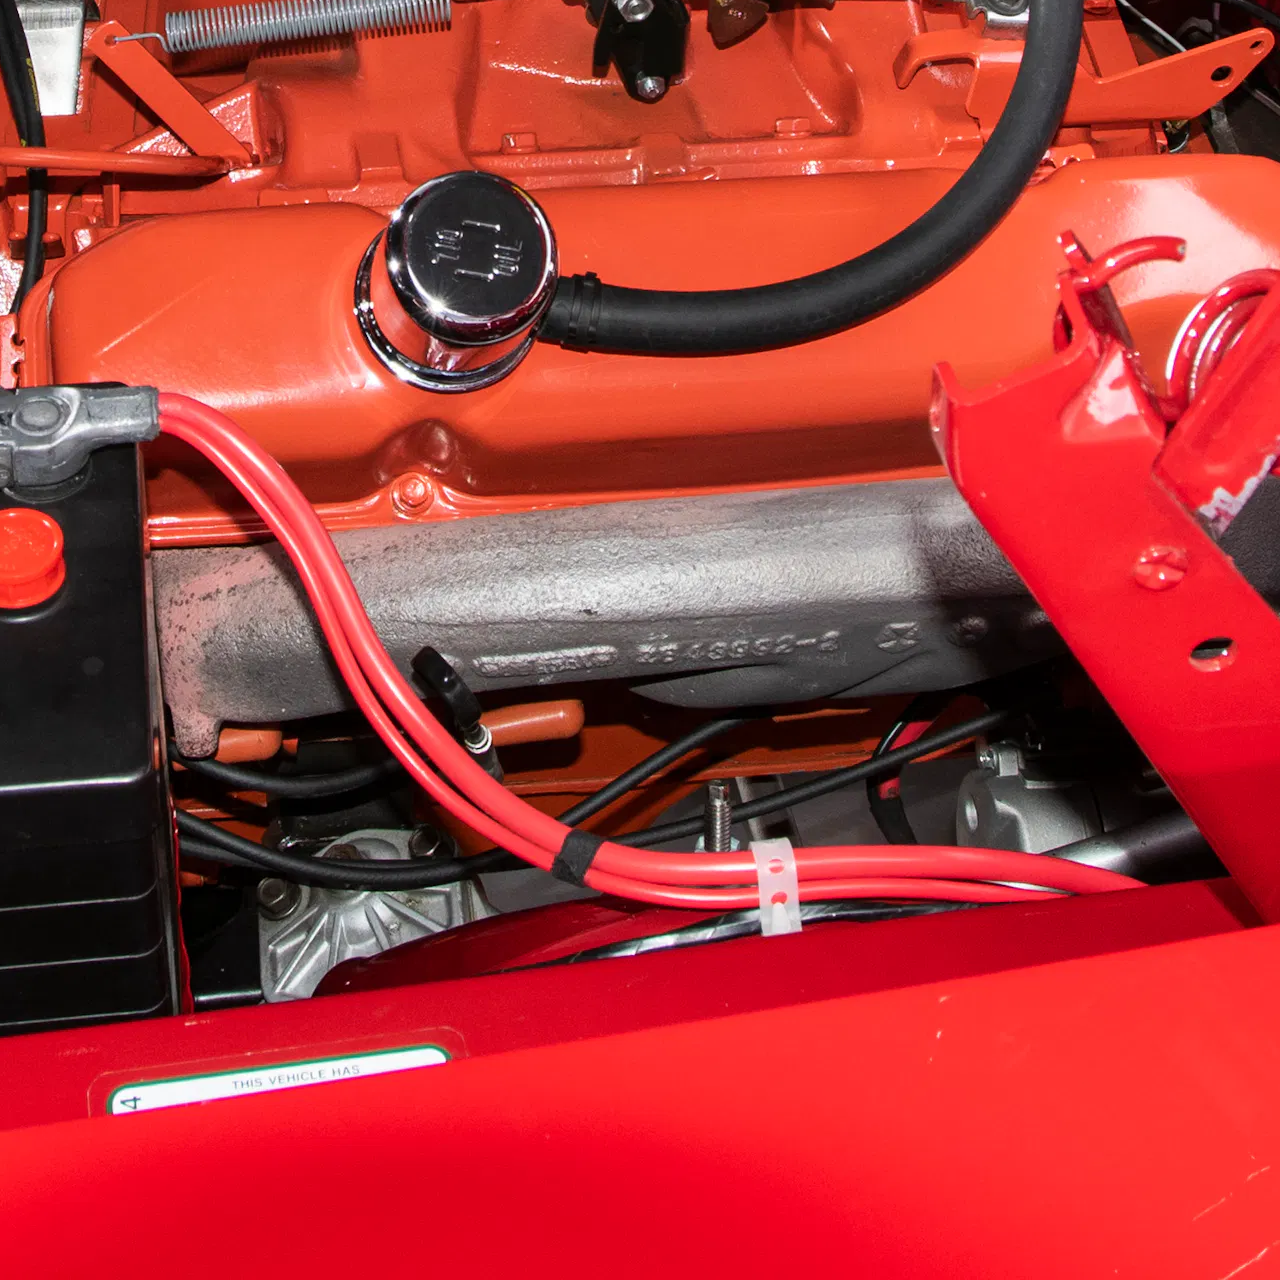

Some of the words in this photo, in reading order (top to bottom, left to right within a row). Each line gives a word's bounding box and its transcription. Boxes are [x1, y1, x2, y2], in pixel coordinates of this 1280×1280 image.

[232, 1076, 263, 1091] THIS
[268, 1070, 327, 1086] VEHICLE
[332, 1064, 361, 1078] HAS
